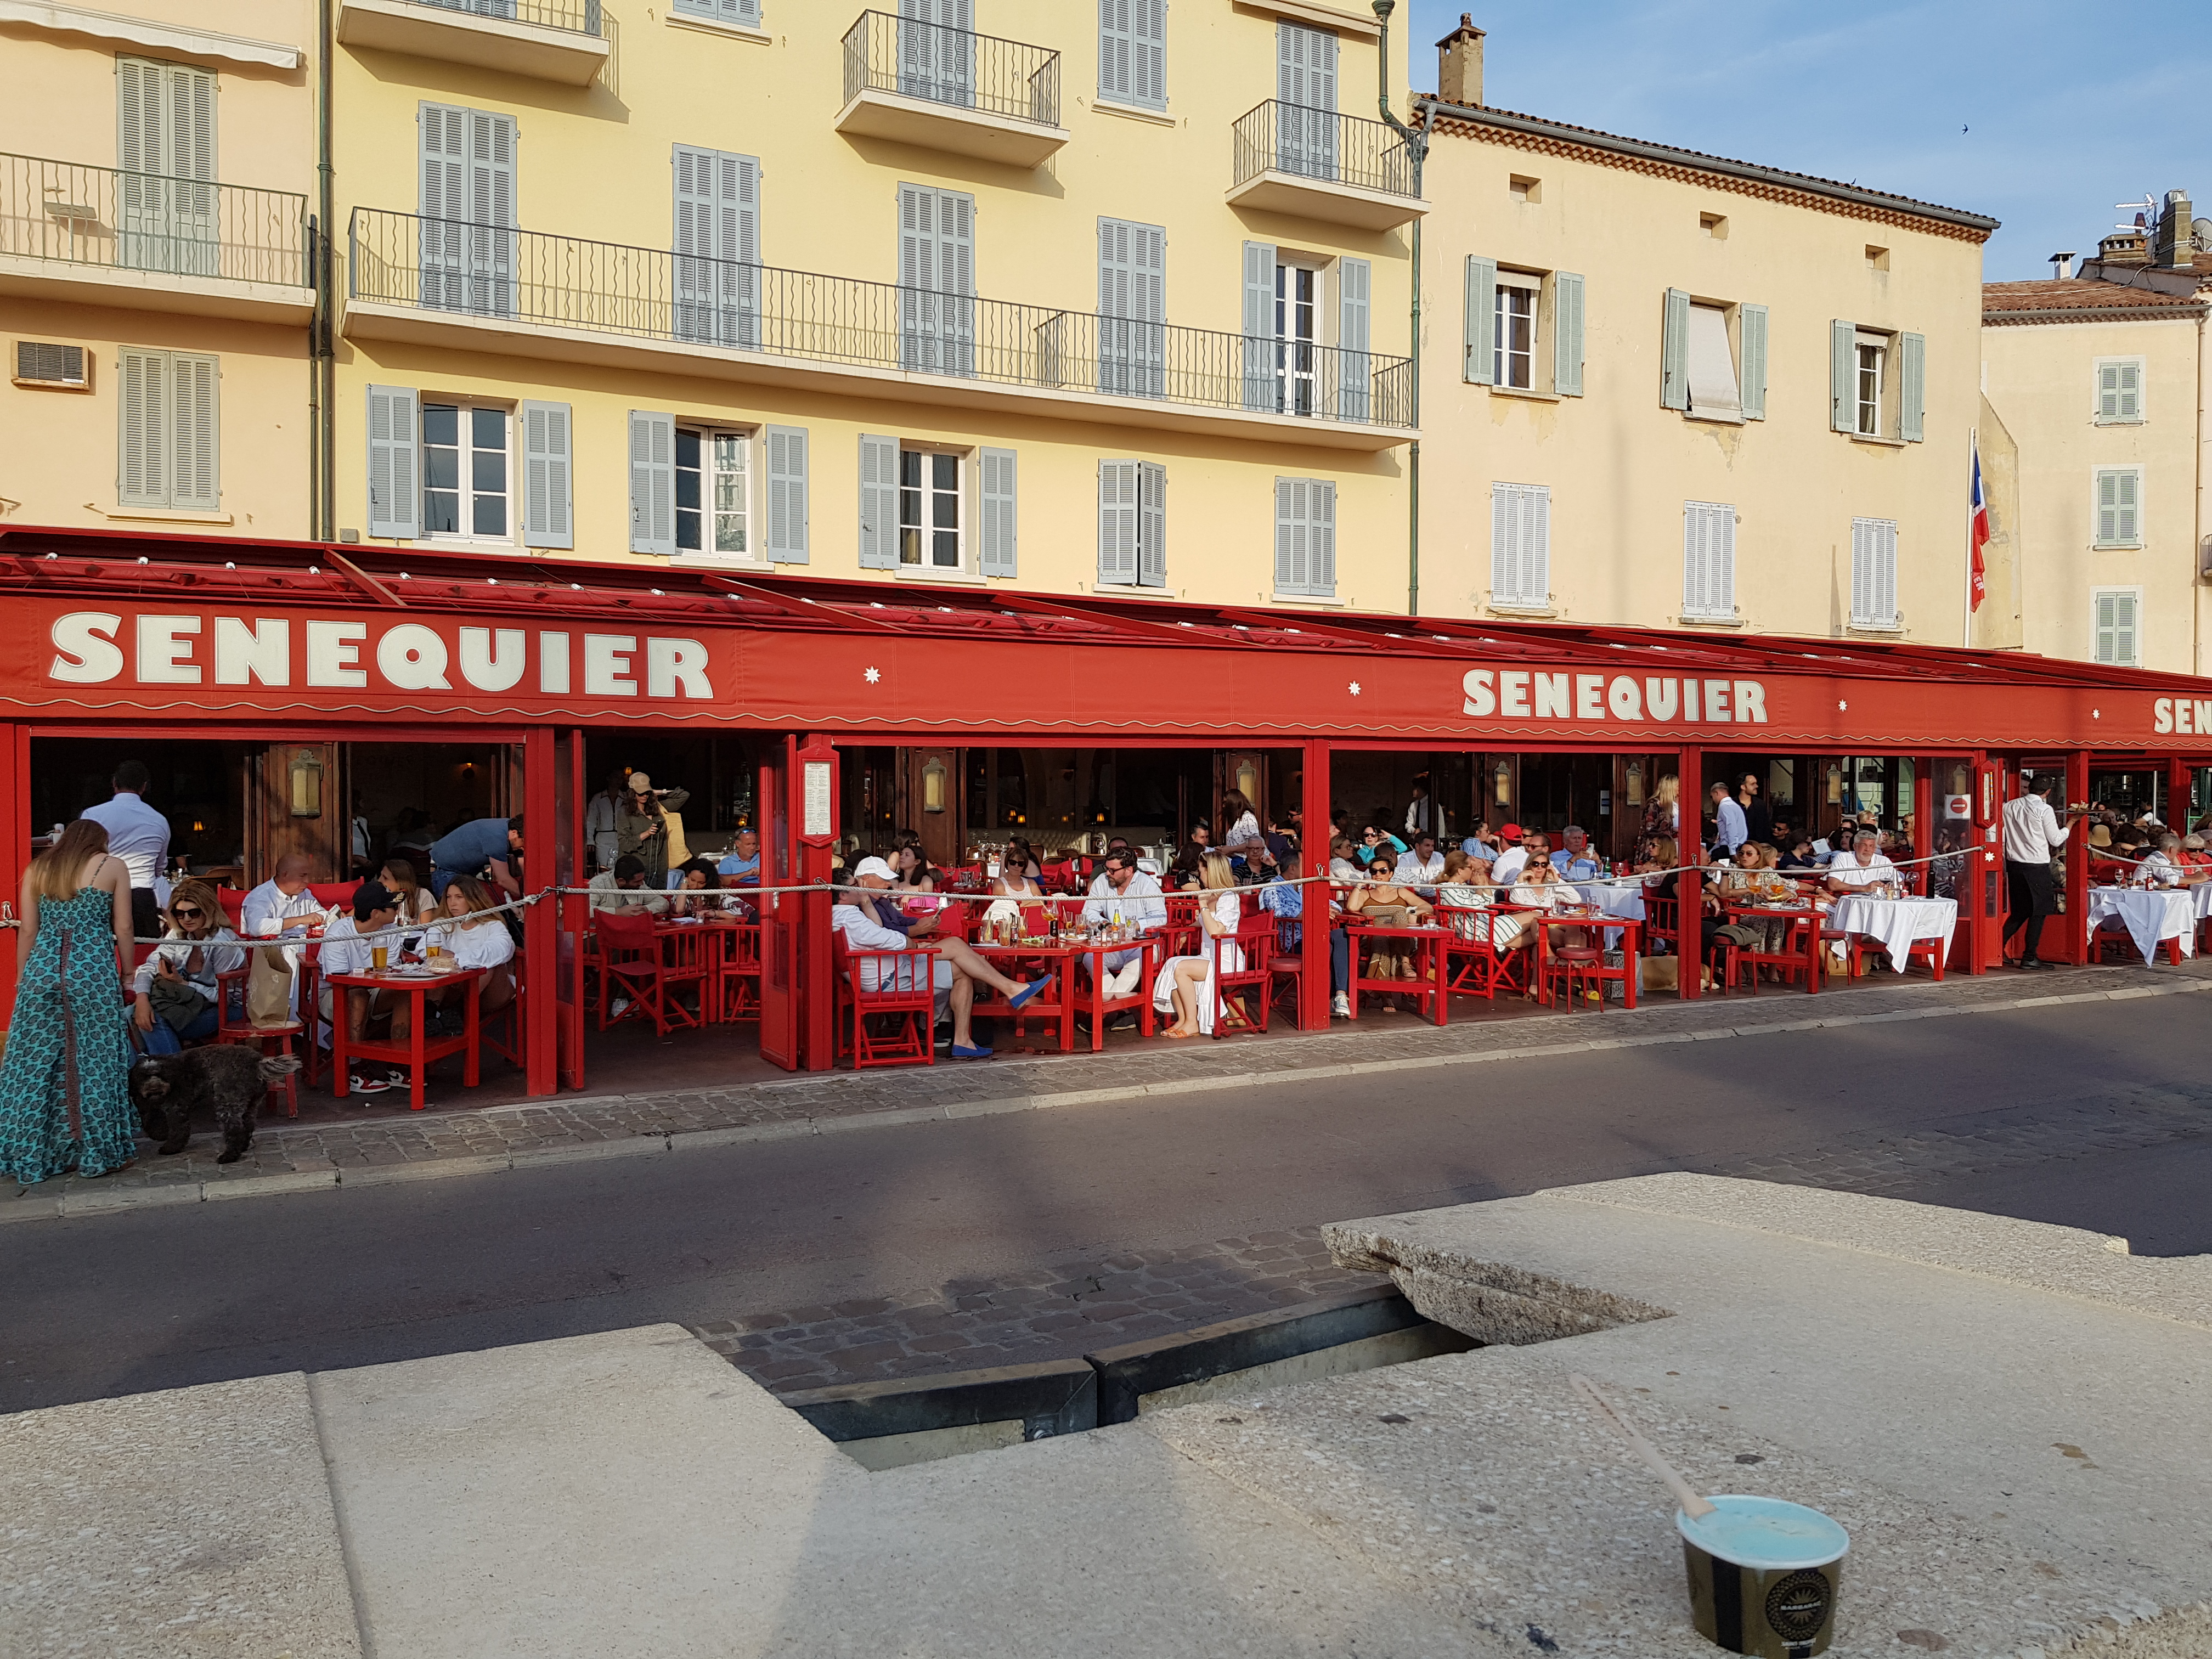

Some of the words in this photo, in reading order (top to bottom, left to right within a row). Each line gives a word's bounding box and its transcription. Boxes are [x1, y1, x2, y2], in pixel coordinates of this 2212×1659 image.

[49, 612, 714, 699] SENEQUIER
[1463, 669, 1768, 723] SENEQUIER
[2154, 697, 2212, 735] SEN
